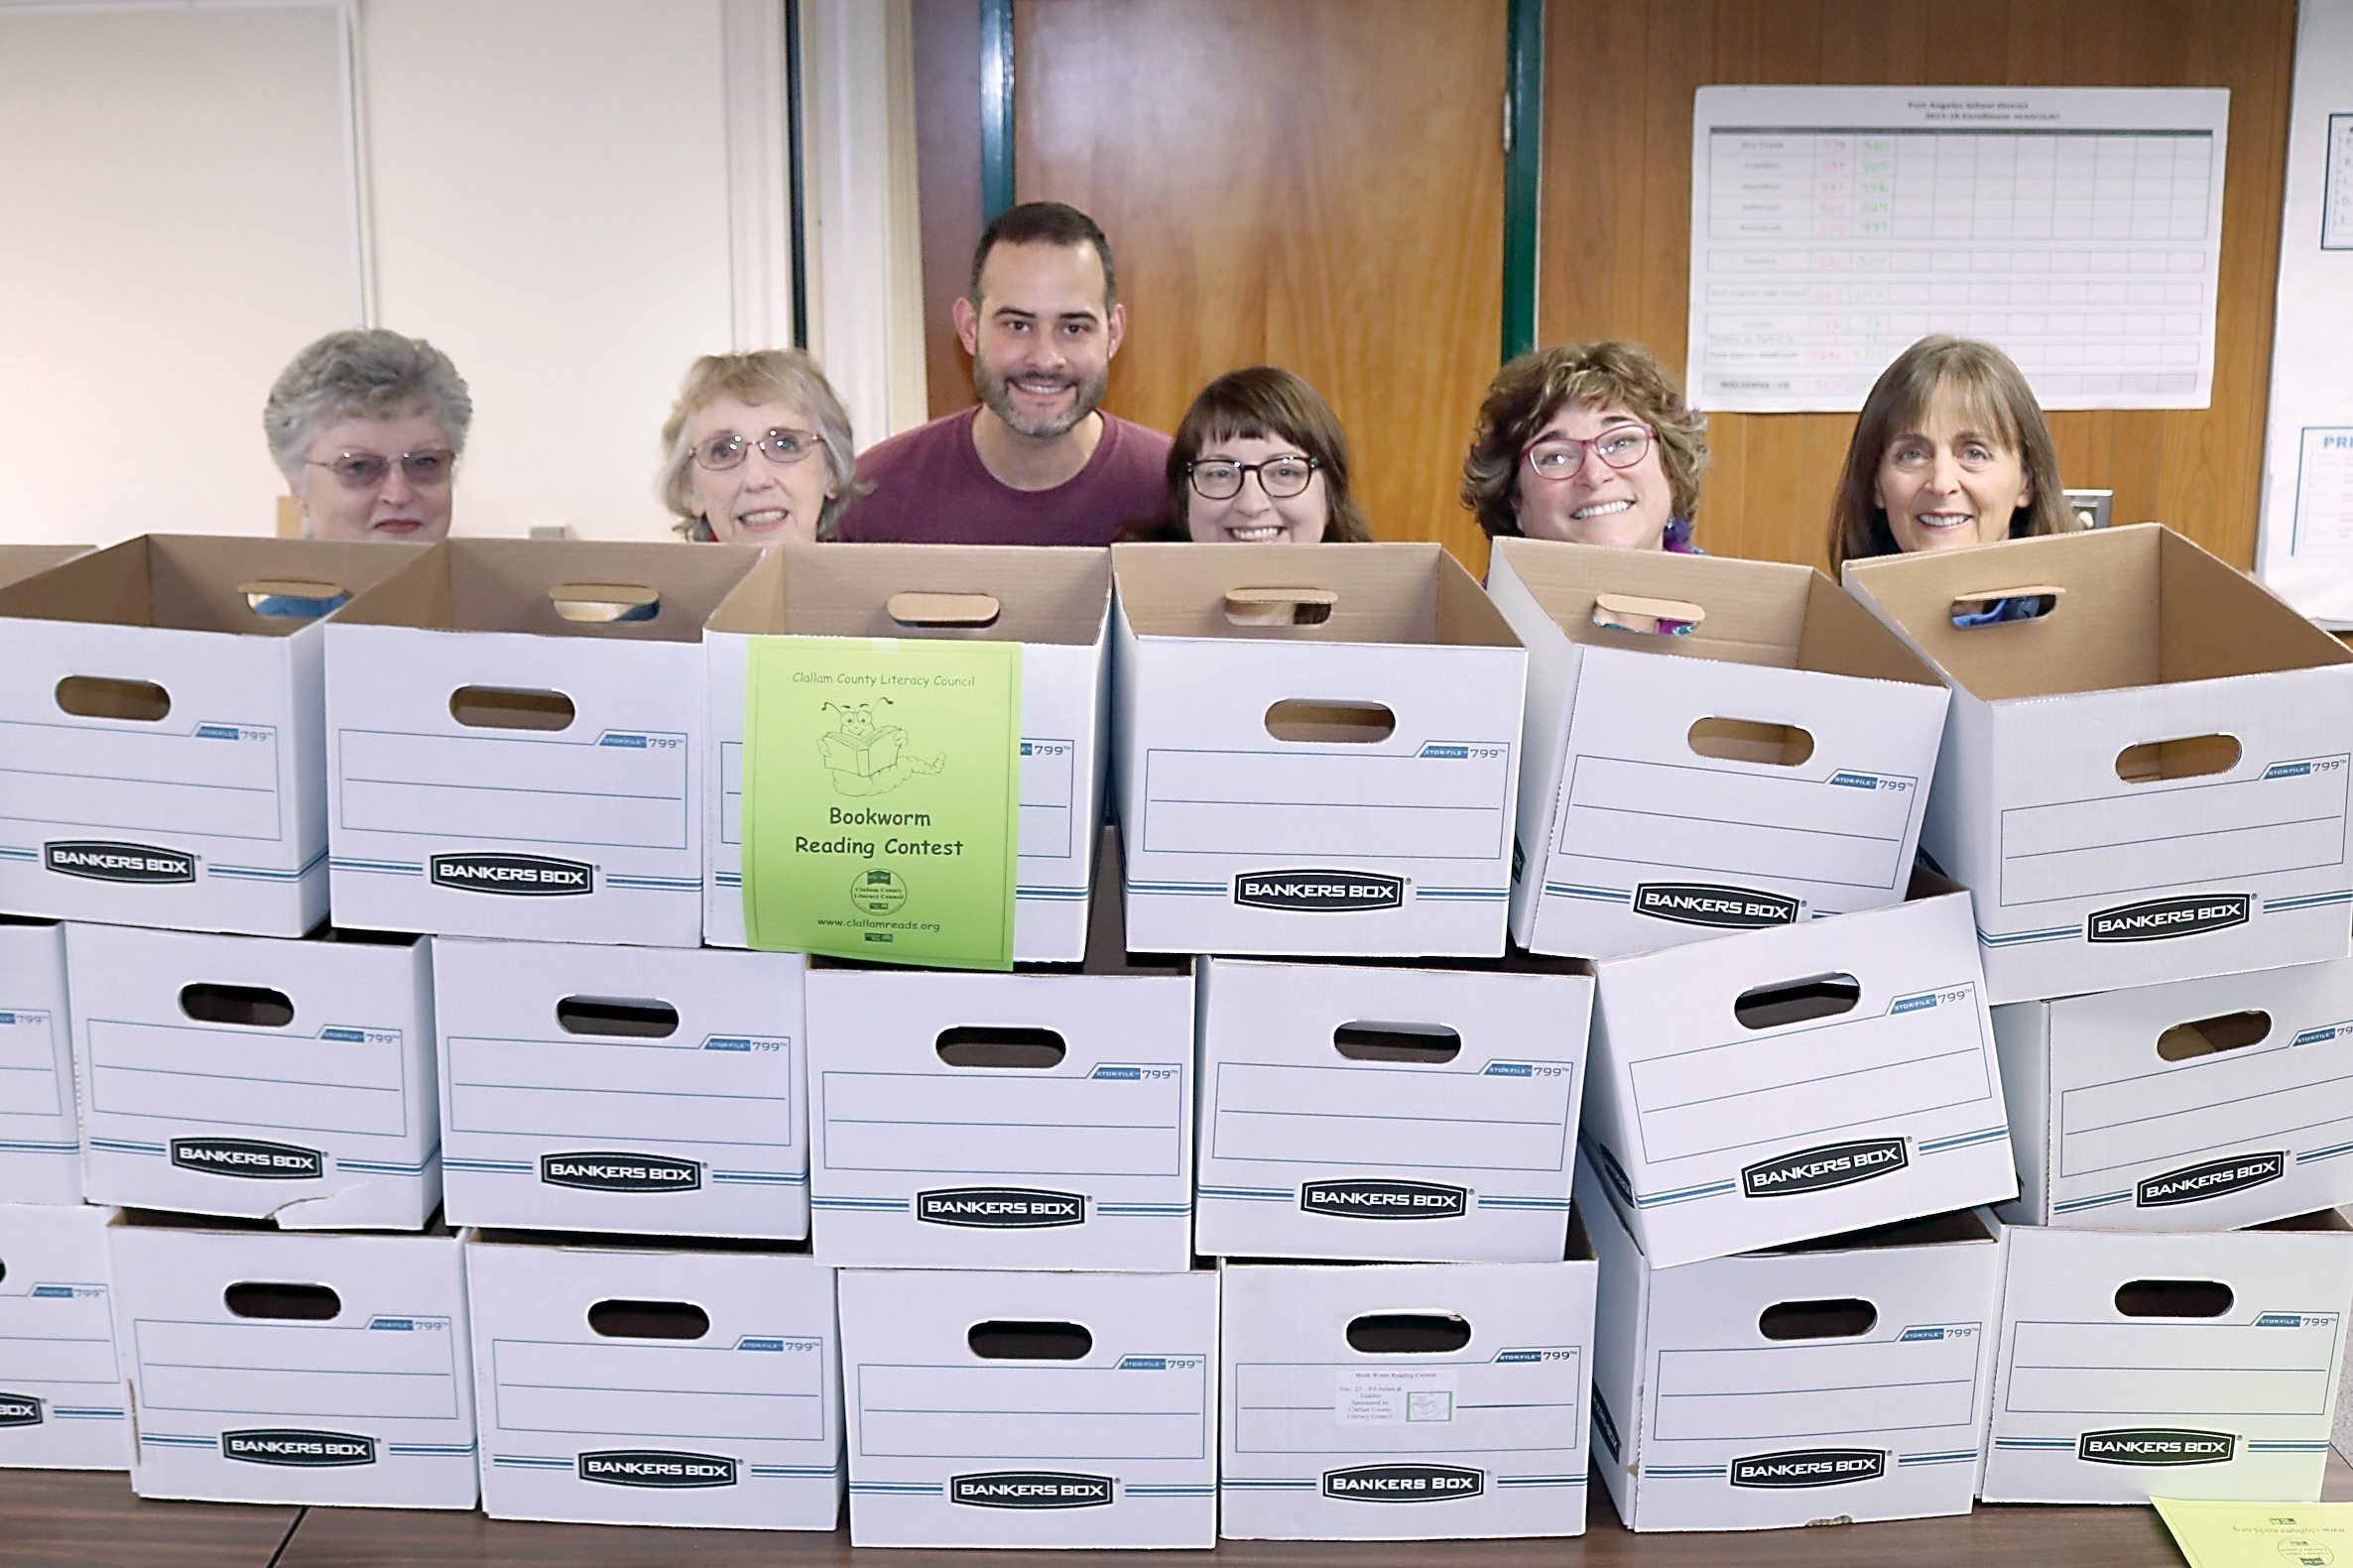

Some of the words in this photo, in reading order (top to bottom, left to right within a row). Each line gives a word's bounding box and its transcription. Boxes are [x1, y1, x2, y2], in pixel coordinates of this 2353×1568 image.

[792, 672, 833, 684] Clallam
[836, 673, 877, 686] County
[880, 674, 929, 688] Literacy
[933, 674, 975, 686] Council
[829, 807, 930, 827] Bookworm
[796, 837, 875, 859] Reading
[884, 837, 964, 856] Contest
[53, 851, 143, 870] BANKERS
[147, 859, 187, 874] BOX
[439, 864, 537, 882] BANKERS
[540, 870, 583, 885] BOX
[1245, 884, 1345, 898] BANKERS
[1349, 886, 1394, 899] BOX
[1645, 894, 1742, 913] BANKERS
[1745, 904, 1788, 919] BOX
[817, 918, 940, 932] www.clallamreads.org
[2098, 910, 2194, 932] BANKERS
[2197, 903, 2241, 919] BOX
[180, 1147, 270, 1166] BANKERS
[273, 1156, 314, 1169] BOX
[551, 1163, 647, 1178] BANKERS
[650, 1168, 692, 1180] BOX
[1753, 1161, 1851, 1187] BANKERS
[1854, 1147, 1899, 1167] BOX
[2147, 1174, 2235, 1198] BANKERS
[2237, 1160, 2276, 1178] BOX
[928, 1201, 1028, 1214] BANKERS
[1031, 1203, 1075, 1215] BOX
[1311, 1191, 1411, 1206] BANKERS
[1414, 1194, 1456, 1208] BOX
[231, 1440, 322, 1454] BANKERS
[325, 1443, 367, 1456] BOX
[2089, 1440, 2180, 1453] BANKERS
[2184, 1441, 2225, 1453] BOX
[587, 1461, 683, 1475] BANKERS
[685, 1464, 728, 1477] BOX
[1741, 1462, 1832, 1478] BANKERS
[1835, 1459, 1877, 1472] BOX
[961, 1485, 1057, 1497] BANKERS
[1060, 1486, 1104, 1497] BOX
[1333, 1479, 1425, 1491] BANKERS
[1431, 1478, 1473, 1489] BOX
